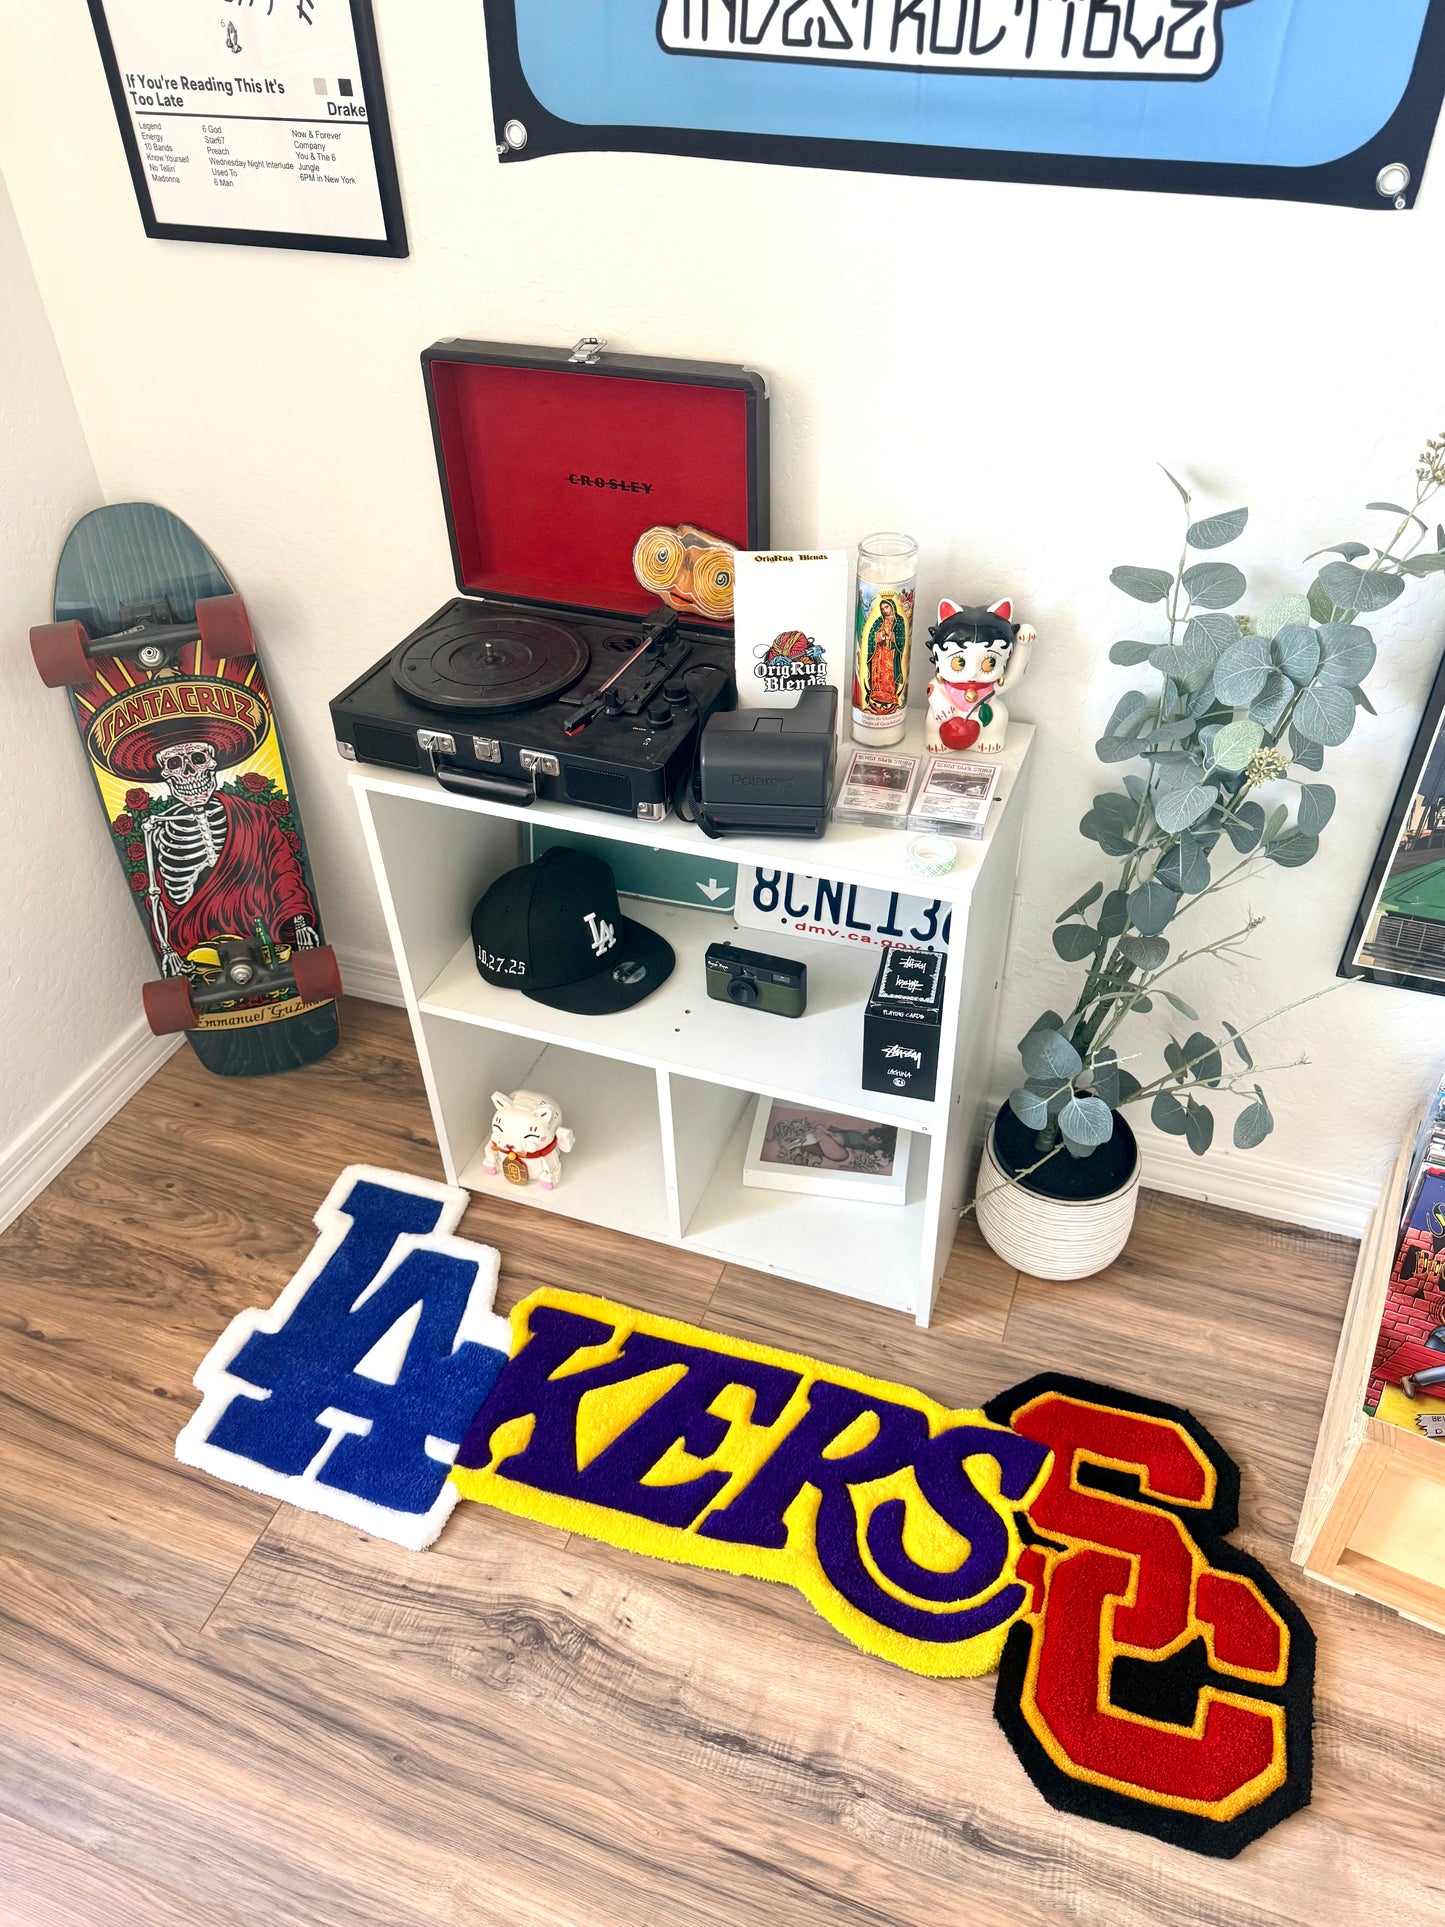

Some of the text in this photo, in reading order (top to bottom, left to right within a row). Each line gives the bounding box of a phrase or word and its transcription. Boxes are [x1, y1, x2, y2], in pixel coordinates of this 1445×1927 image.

[126, 73, 285, 96] If You're Reading This It's
[129, 91, 184, 107] Too Late
[327, 101, 366, 117] Drake
[138, 121, 162, 131] Legend
[202, 124, 222, 133] 6 God
[141, 132, 163, 142] Energy
[291, 129, 341, 140] Now & Forever
[204, 136, 225, 144] Star67
[144, 142, 173, 152] 10 Bands
[207, 146, 230, 155] Preach
[293, 140, 326, 151] Company
[146, 153, 190, 163] Know Yourself
[295, 151, 336, 161] You & The 6
[149, 163, 159, 172] No
[208, 157, 295, 170] Wednesday Night Interlude
[298, 163, 320, 173] Jungle
[211, 168, 238, 177] Used To
[151, 174, 181, 183] Madonna
[213, 178, 234, 187] 6 Man
[299, 173, 356, 184] 6PM in New York
[567, 473, 654, 495] CROSLEY
[754, 661, 827, 678] OrigRug
[100, 685, 257, 755] SANTA CRUZ
[583, 912, 617, 957] LA
[794, 922, 921, 951] dmv.ca.gov
[477, 944, 526, 975] 10.27.25
